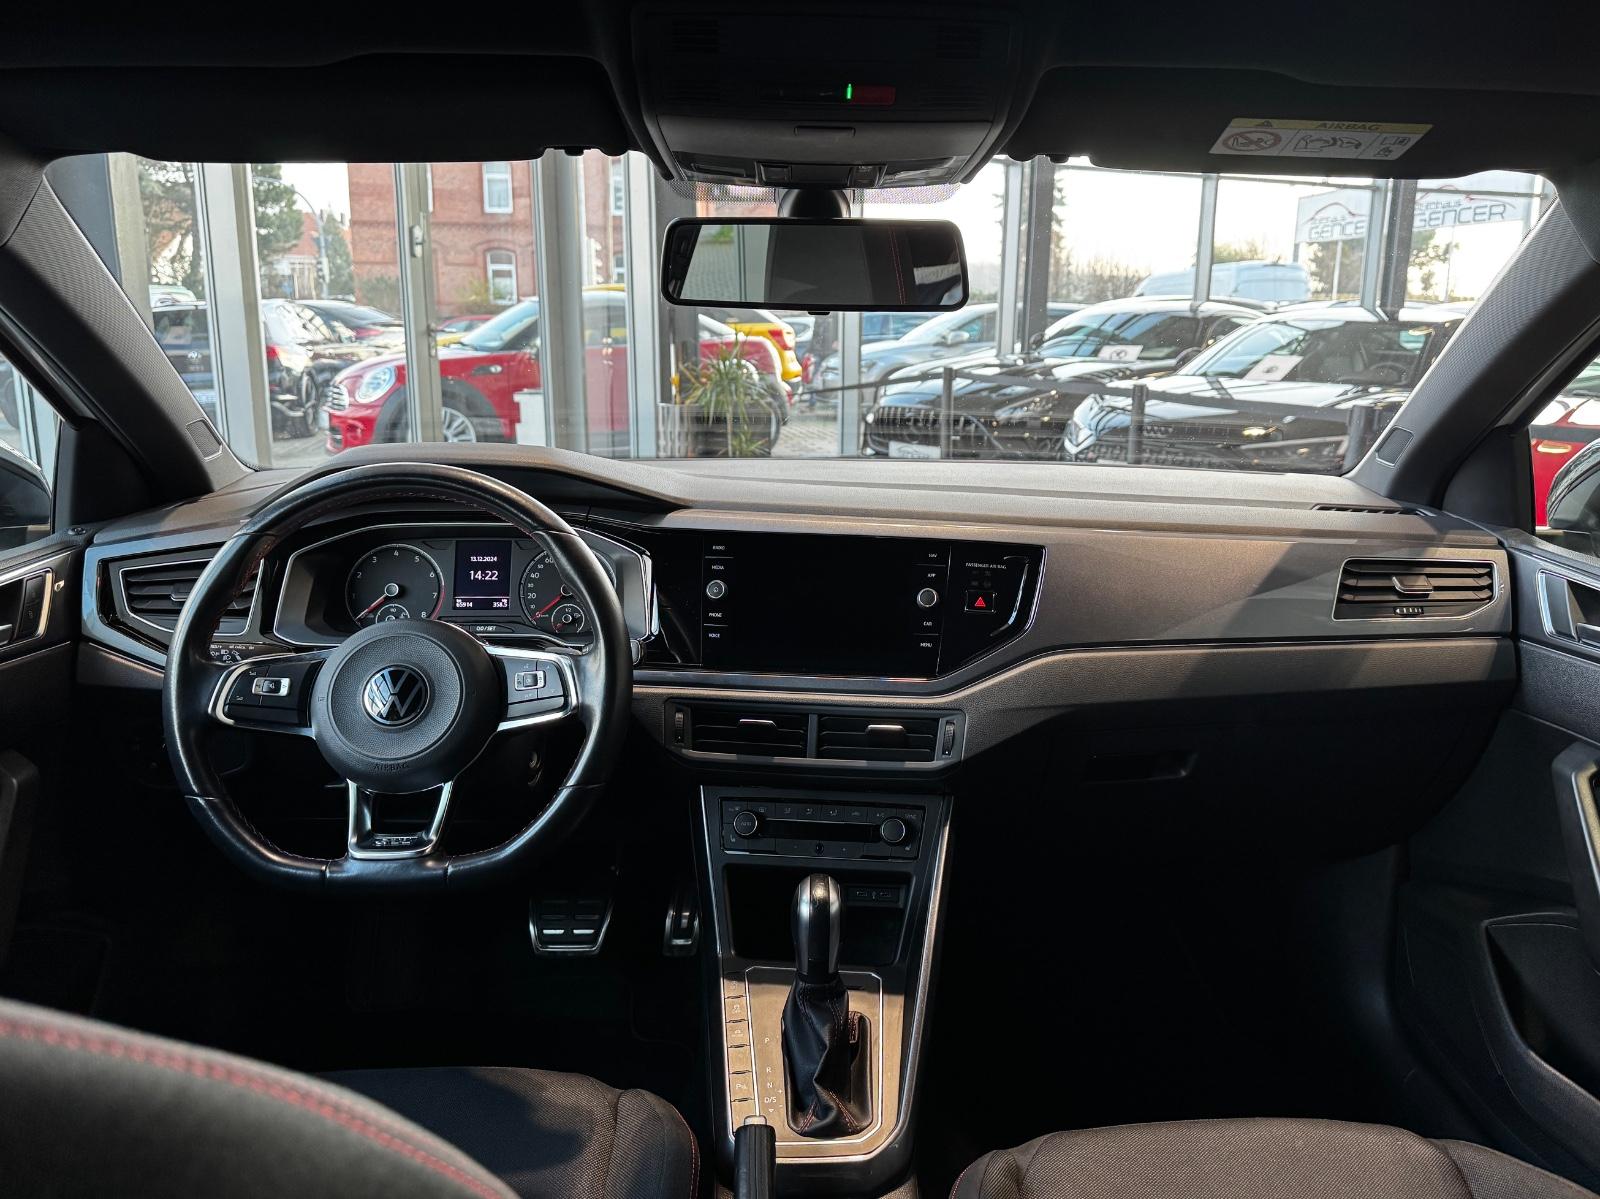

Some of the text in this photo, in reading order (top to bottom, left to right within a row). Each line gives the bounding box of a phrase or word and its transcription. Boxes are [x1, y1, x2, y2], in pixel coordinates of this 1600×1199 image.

[1316, 122, 1381, 131] AIRBAG
[1308, 219, 1365, 240] GENCE
[469, 570, 499, 581] 14:22
